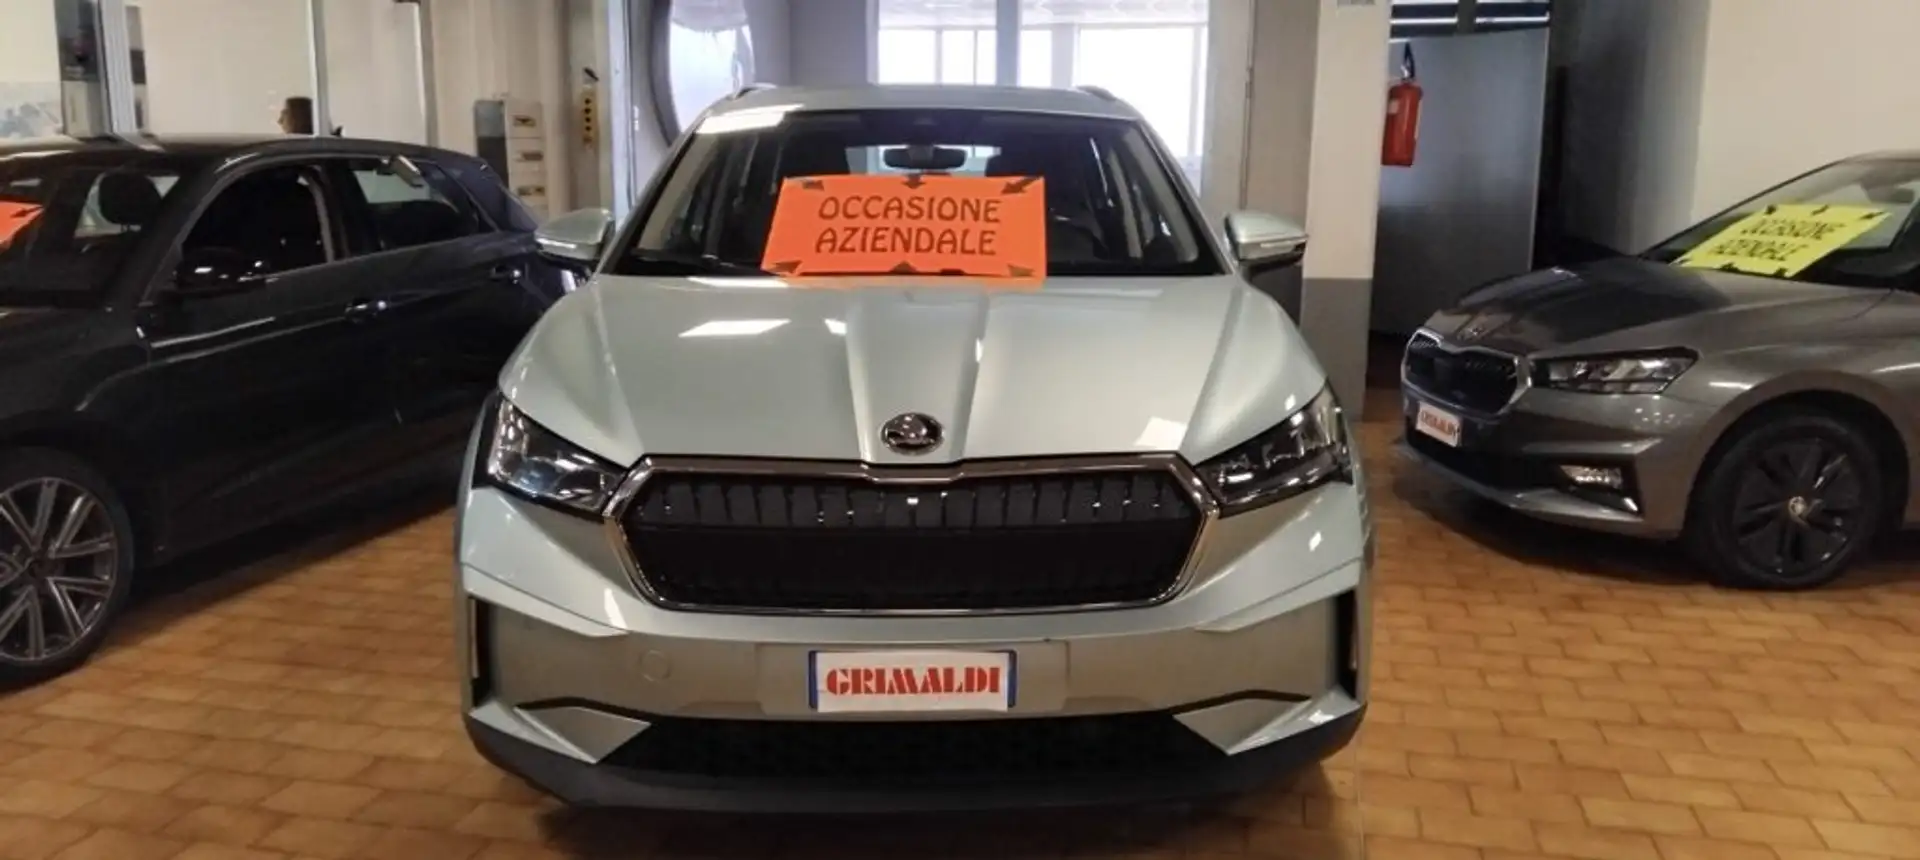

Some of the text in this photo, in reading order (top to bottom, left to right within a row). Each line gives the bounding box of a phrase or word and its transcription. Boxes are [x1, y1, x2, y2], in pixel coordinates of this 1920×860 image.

[818, 196, 1001, 223] OCCASIONE
[815, 226, 996, 255] AZIENDALE
[826, 667, 1001, 695] GRIMALDI
